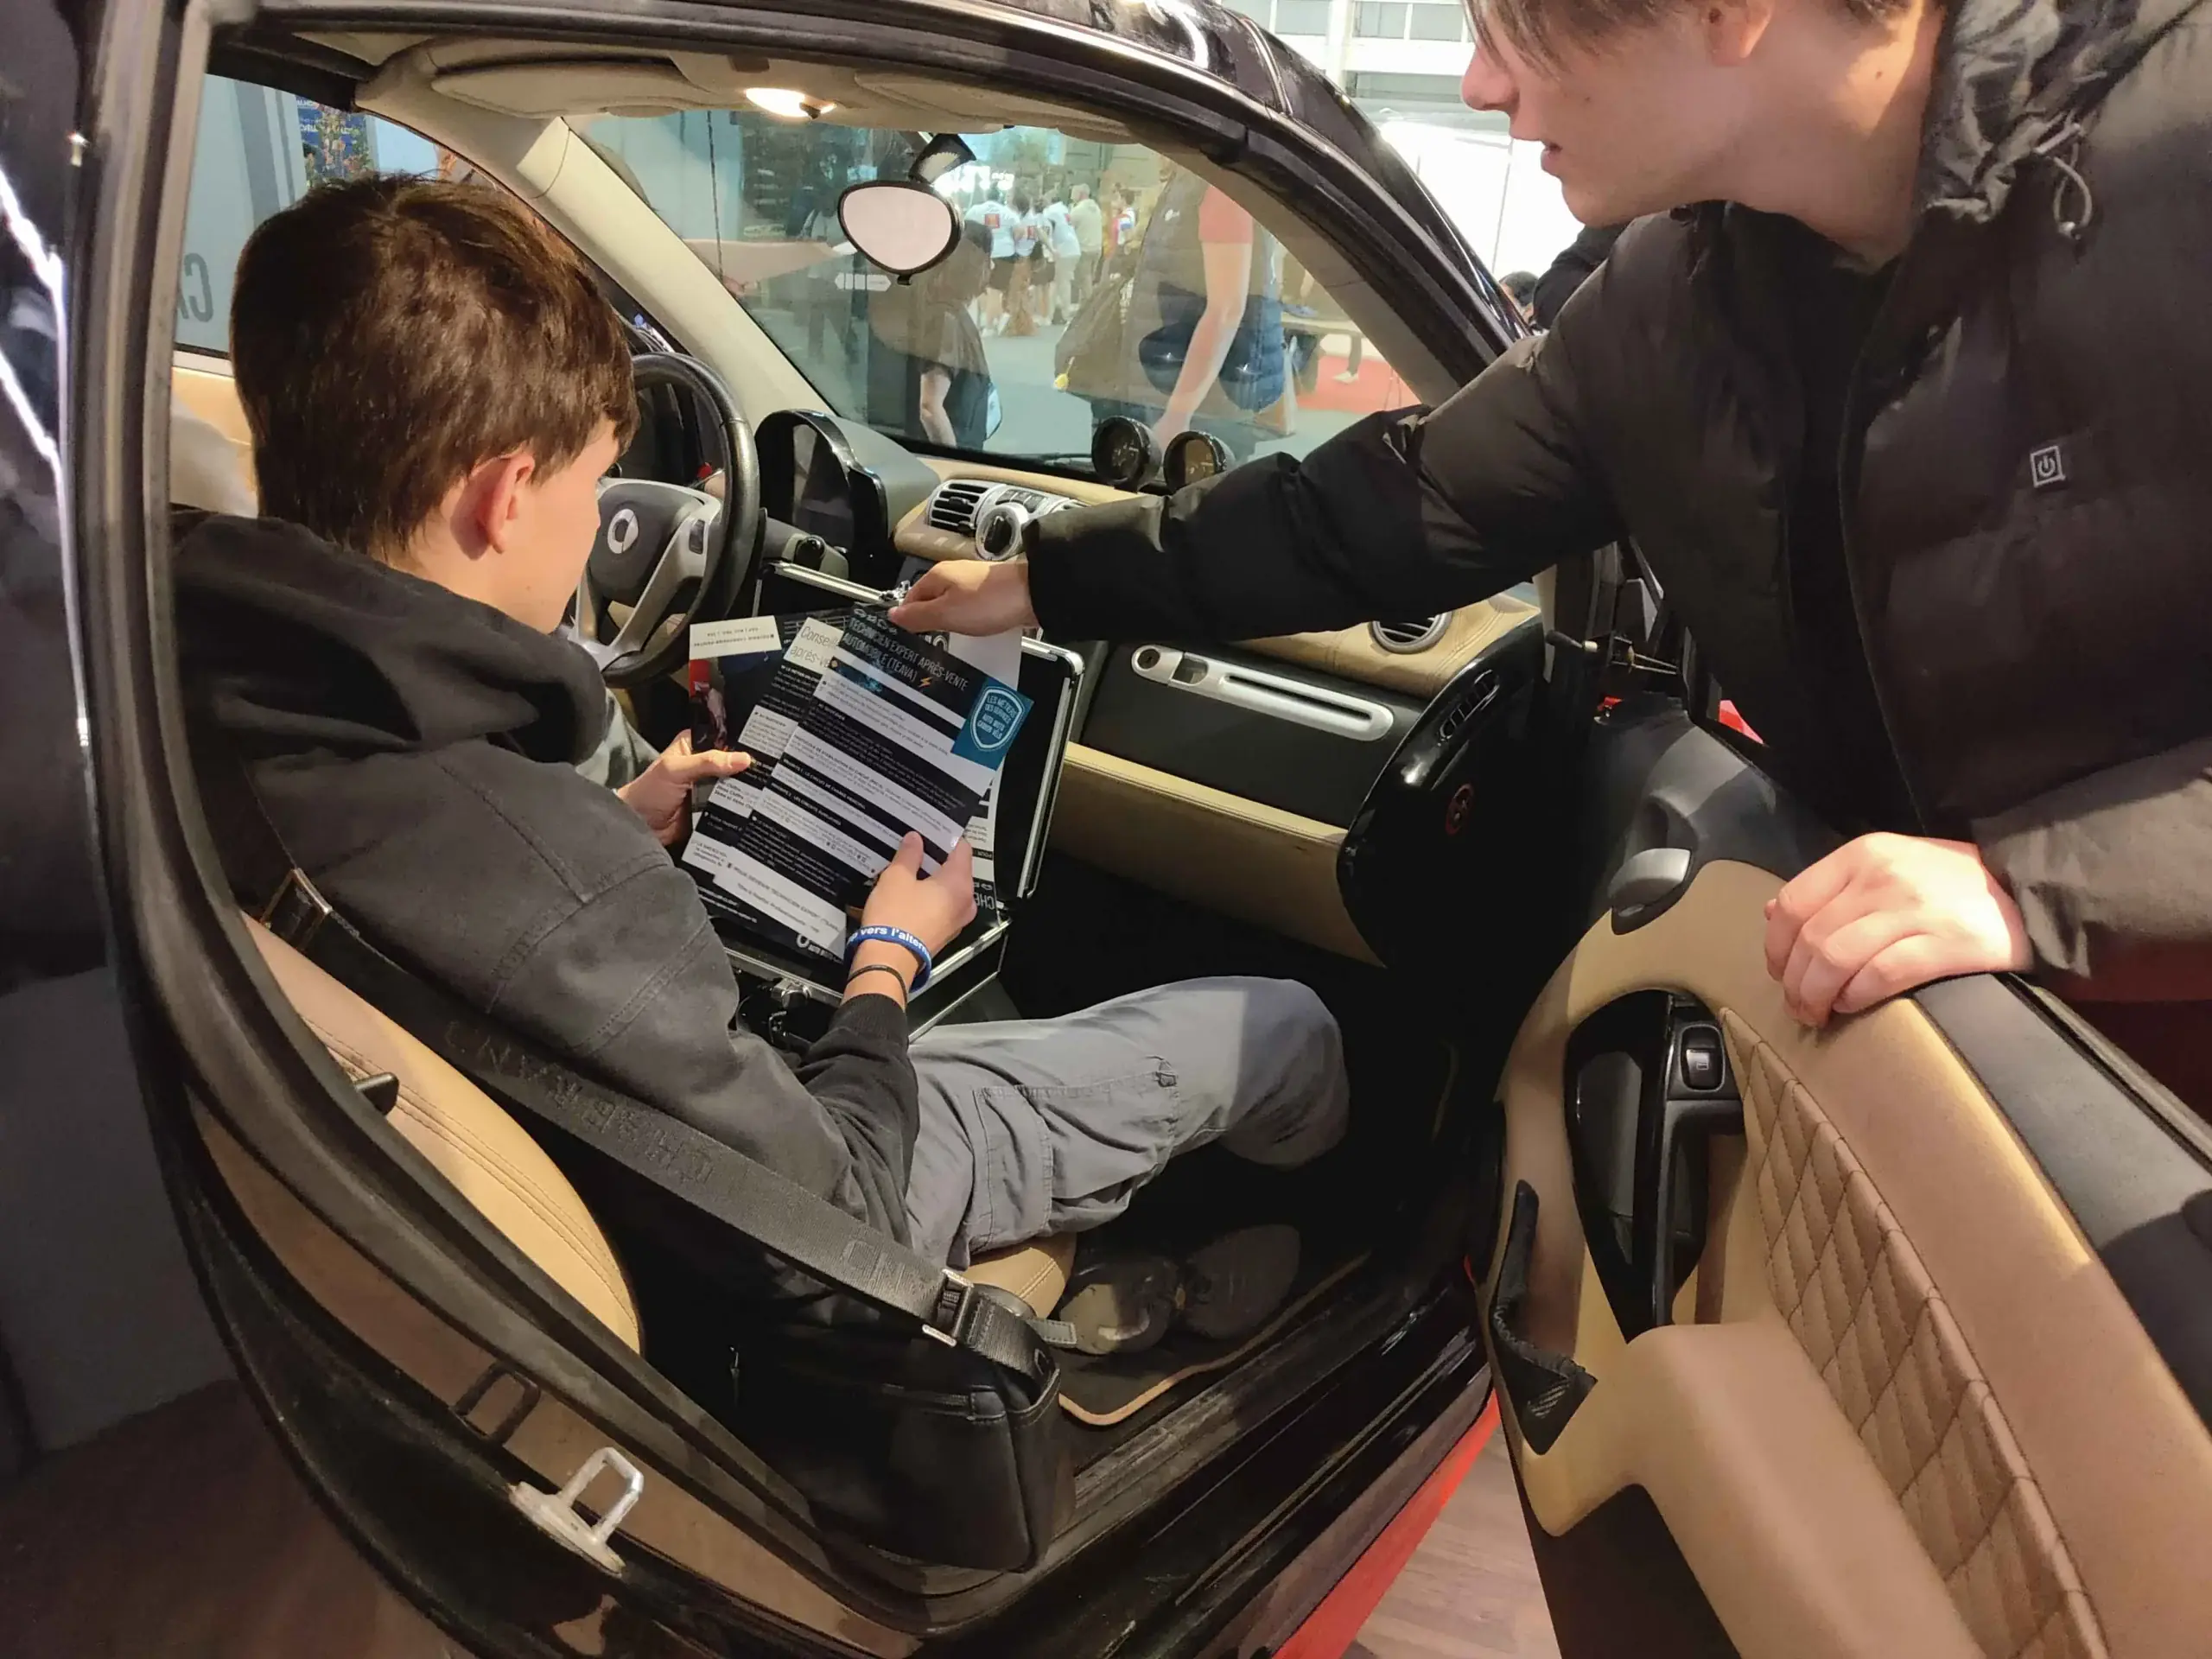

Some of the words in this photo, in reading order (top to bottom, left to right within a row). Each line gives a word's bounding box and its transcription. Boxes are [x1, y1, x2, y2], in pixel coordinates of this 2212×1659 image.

[842, 632, 889, 665] AUTOMOBILE
[887, 656, 918, 682] (TEAVA)
[849, 617, 891, 648] TECHNICIEN
[890, 639, 919, 663] EXPERT
[918, 655, 969, 691] APRÈS-VENTE
[987, 695, 998, 704] LES
[860, 927, 888, 936] vers
[891, 927, 931, 957] l'altern
